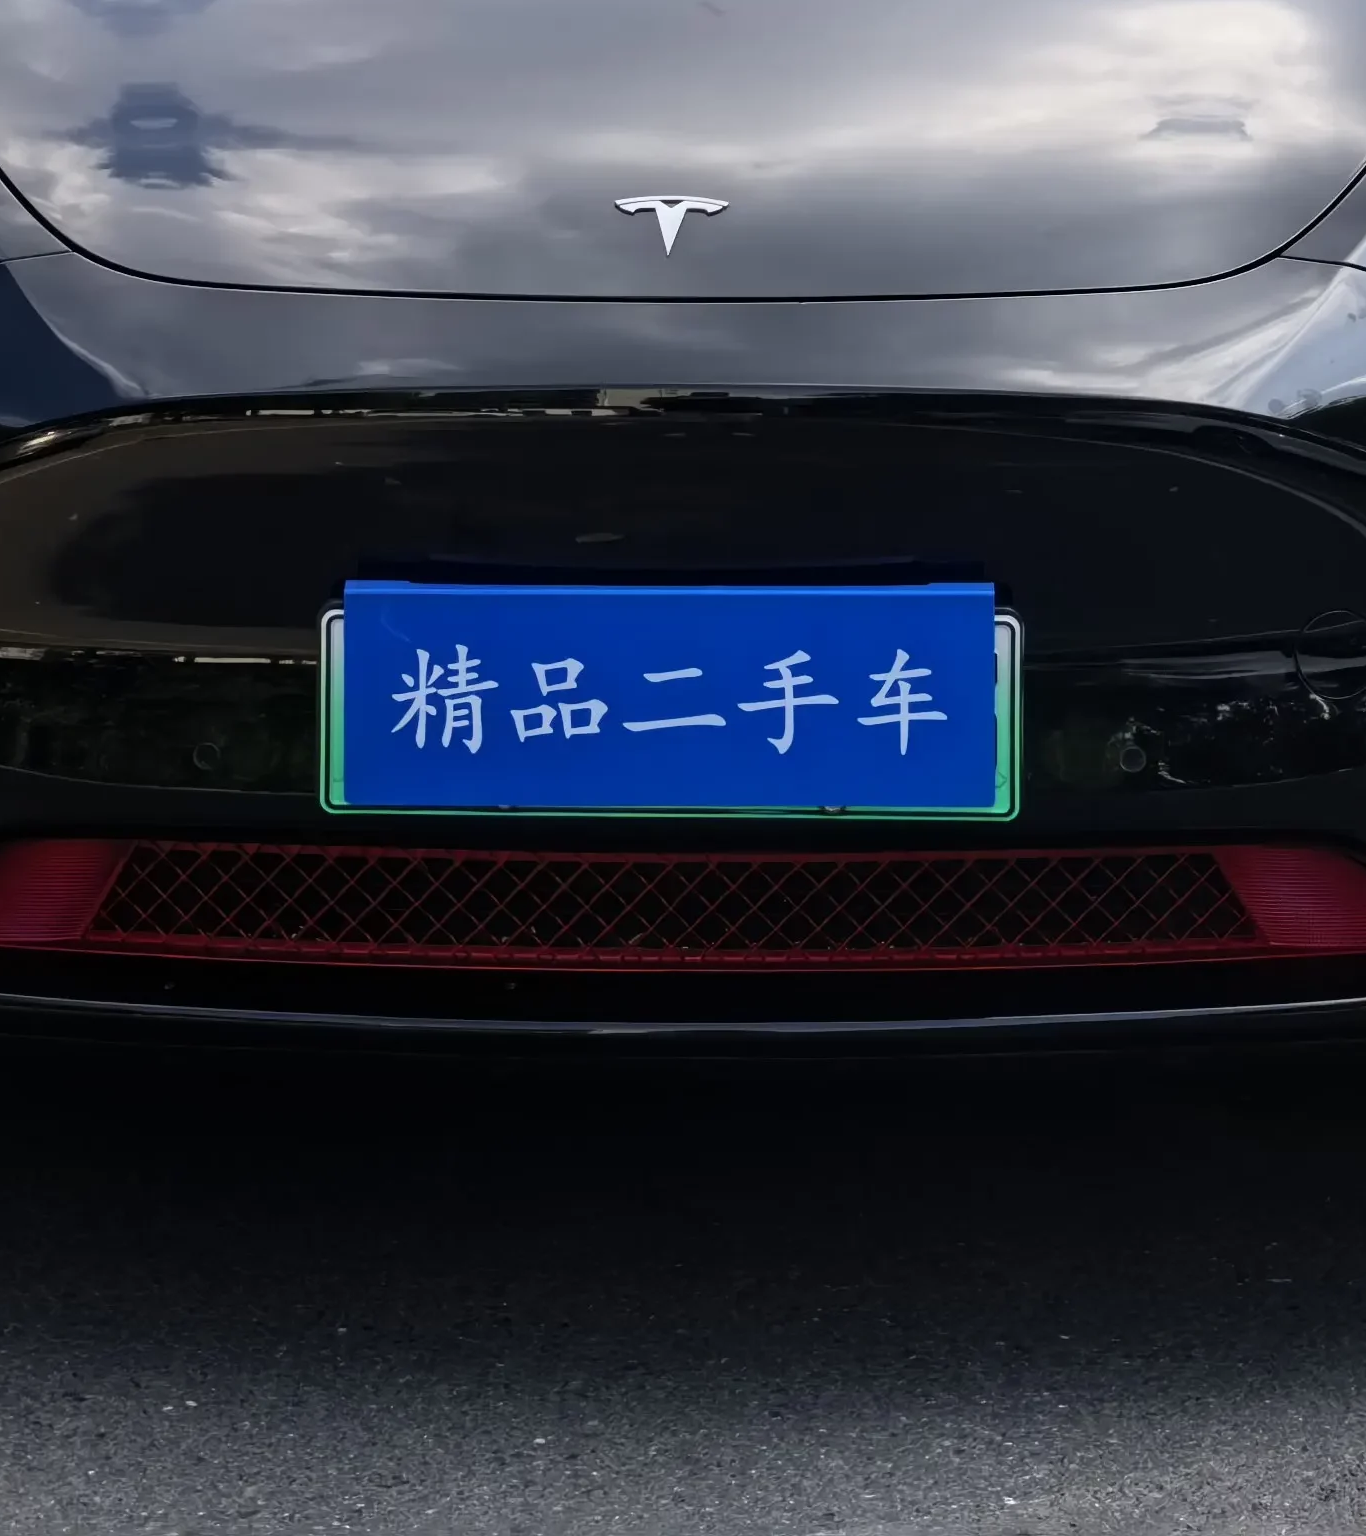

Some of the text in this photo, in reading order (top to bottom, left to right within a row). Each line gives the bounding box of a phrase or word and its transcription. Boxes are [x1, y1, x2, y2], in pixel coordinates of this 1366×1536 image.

[391, 644, 948, 755] 精品二手车
